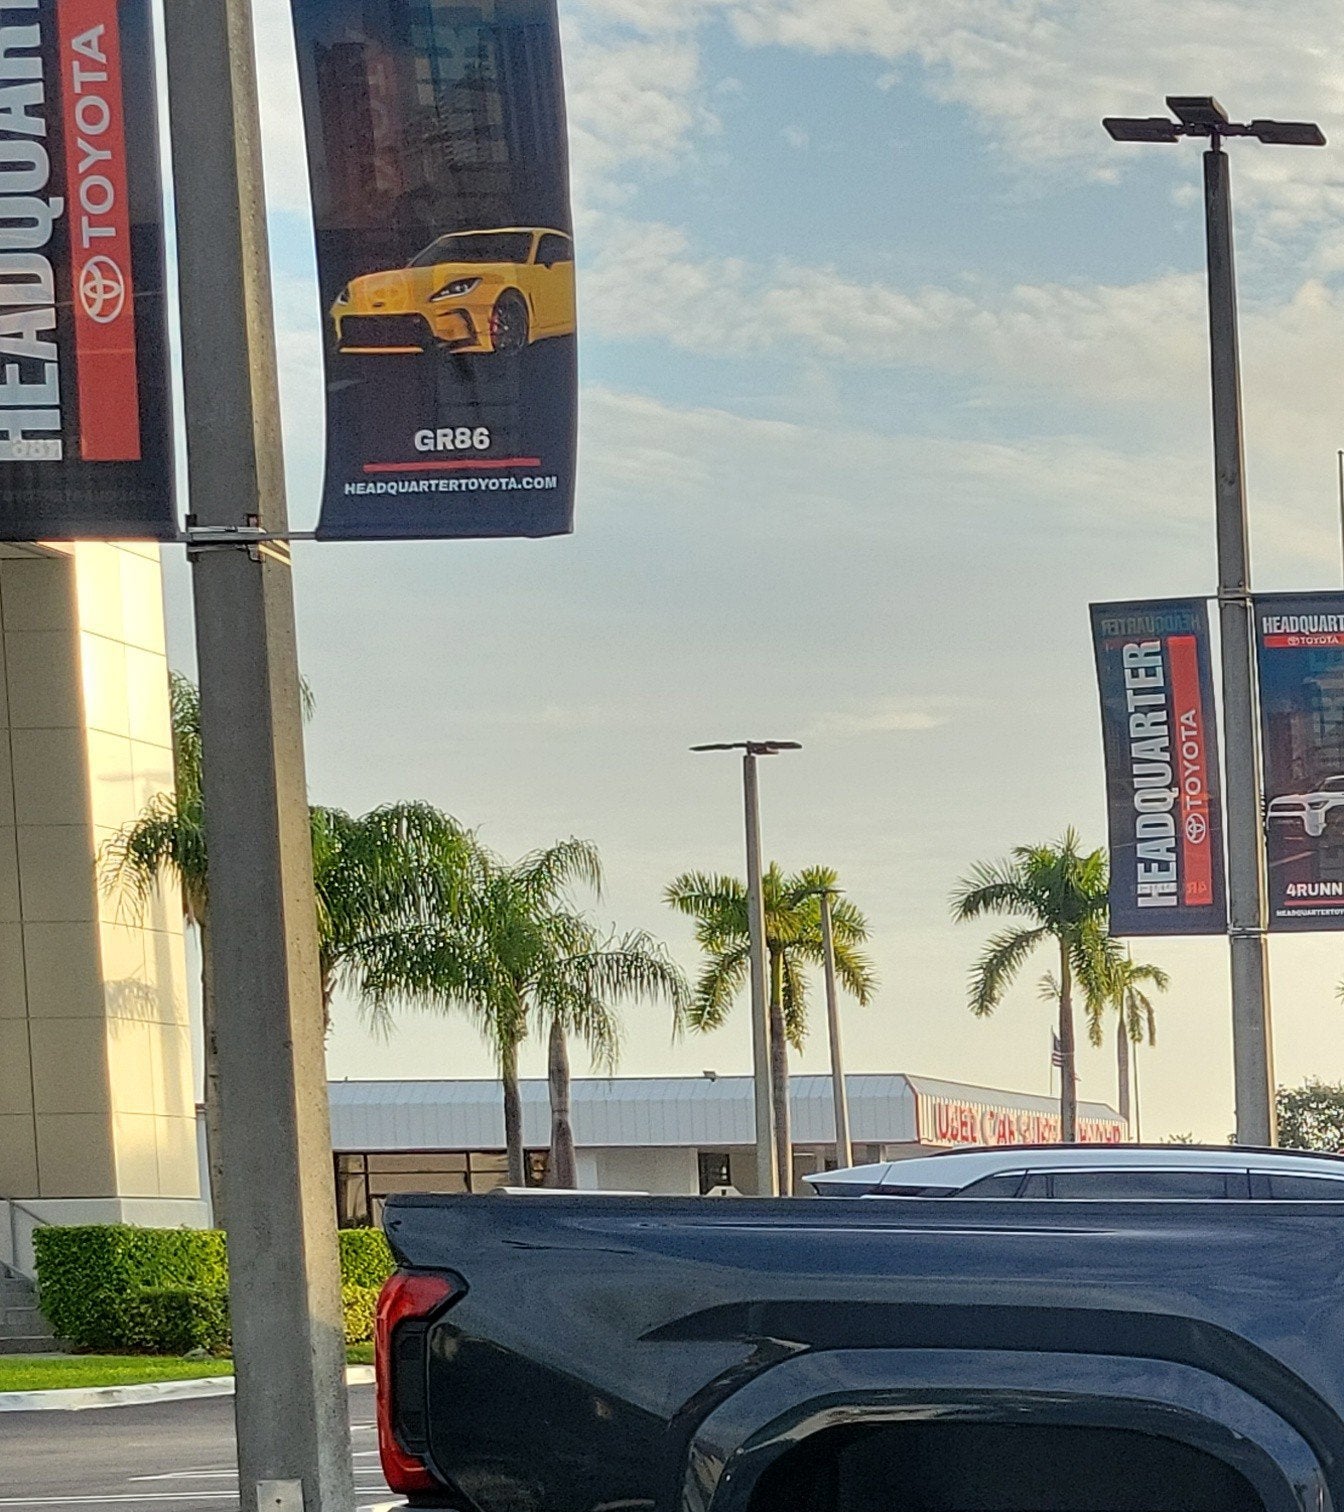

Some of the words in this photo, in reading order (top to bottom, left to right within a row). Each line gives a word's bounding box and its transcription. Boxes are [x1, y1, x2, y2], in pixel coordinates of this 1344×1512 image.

[71, 23, 117, 249] TOYOTA
[414, 426, 491, 452] GR86
[344, 475, 558, 496] HEADQUARTERTOYOTA.COM
[1300, 635, 1339, 645] TOYOTA
[1122, 639, 1179, 908] HEADQUARTER
[1181, 708, 1203, 811] TOYOTA
